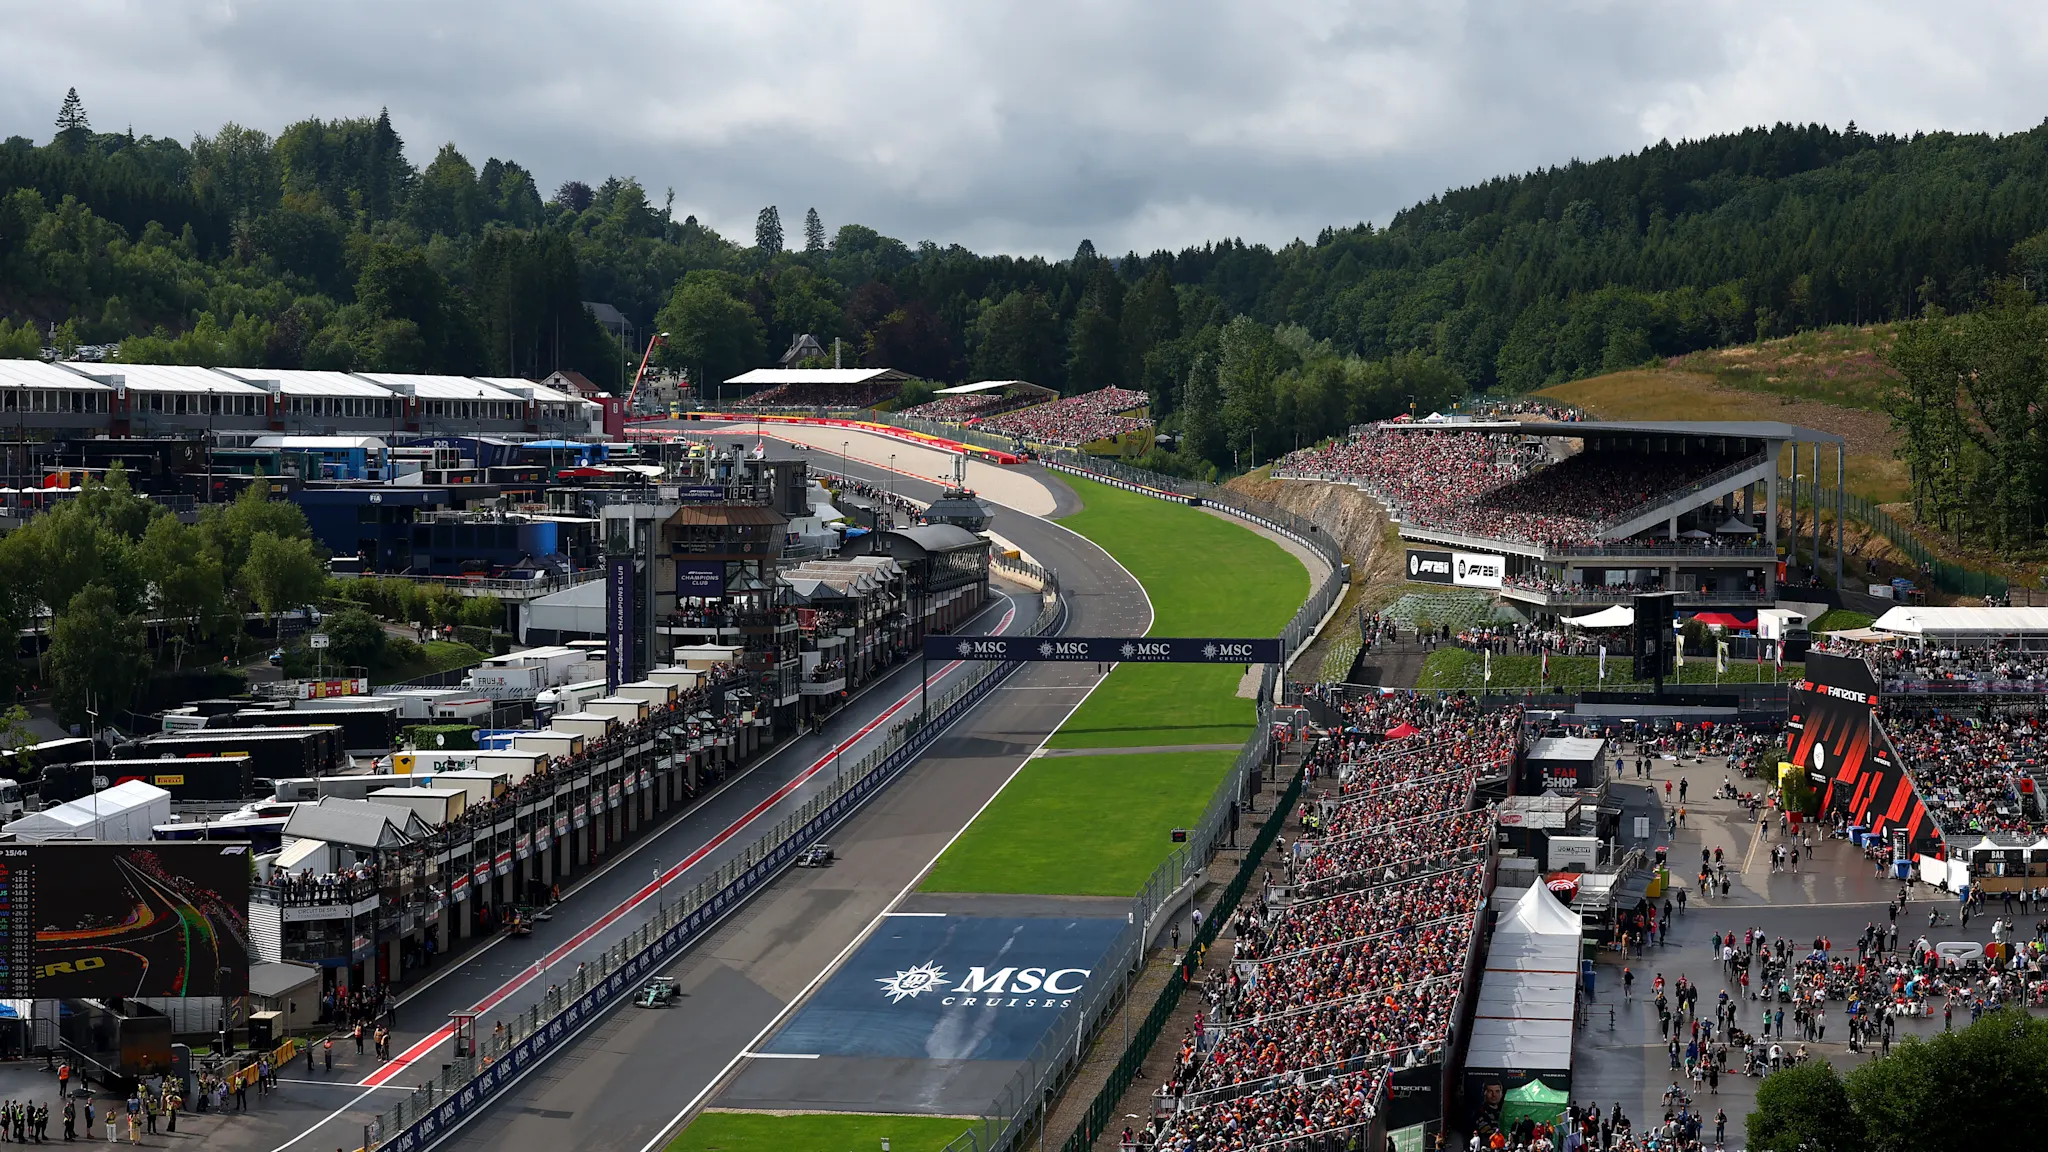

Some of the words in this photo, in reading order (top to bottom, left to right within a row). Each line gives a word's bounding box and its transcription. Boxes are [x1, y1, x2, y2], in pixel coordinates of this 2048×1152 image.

[974, 642, 1007, 653] MSC
[1055, 642, 1088, 654] MSC
[1137, 643, 1170, 655] MSC
[1219, 644, 1252, 656] MSC
[1827, 685, 1867, 704] FANZONE
[166, 722, 198, 730] enterprise
[1554, 767, 1577, 778] FAN
[157, 776, 182, 784] PIRELLI
[1546, 777, 1578, 788] SHOP
[4, 849, 28, 857] 15/44
[1991, 850, 2005, 859] BAR
[951, 966, 1091, 994] MSC
[942, 997, 1072, 1008] CRUISES
[536, 1032, 546, 1048] MSC
[519, 1045, 529, 1061] MSC
[501, 1058, 512, 1075] MSC
[482, 1072, 494, 1089] MSC
[463, 1086, 475, 1104] MSC
[444, 1101, 456, 1118] MSC
[423, 1116, 435, 1133] MSC
[402, 1131, 414, 1150] MSC
